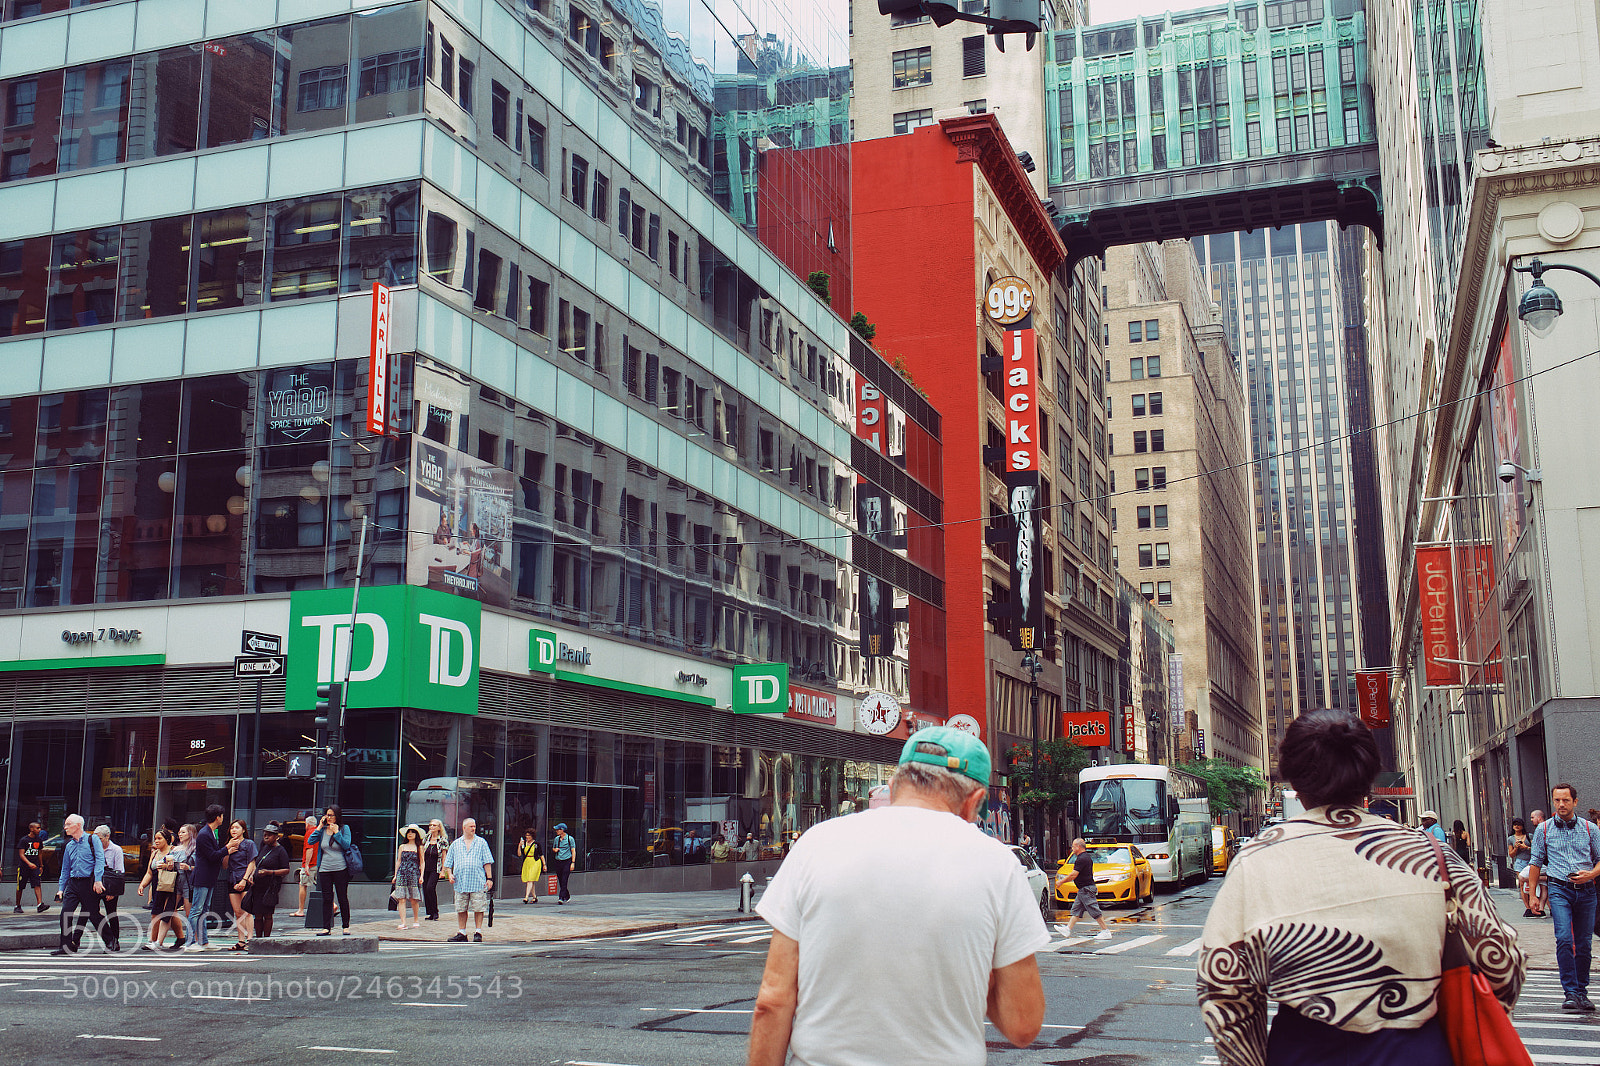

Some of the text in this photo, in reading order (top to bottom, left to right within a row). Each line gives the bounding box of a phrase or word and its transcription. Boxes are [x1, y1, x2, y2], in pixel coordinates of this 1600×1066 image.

[988, 285, 1031, 319] 99¢
[375, 291, 386, 417] BARILLA
[290, 373, 309, 386] THE
[269, 386, 328, 417] YARD
[1008, 330, 1031, 470] jacks
[270, 416, 323, 429] SPACE TO WORK
[420, 460, 443, 481] YARD
[1017, 490, 1029, 570] TWININGS
[1425, 562, 1450, 671] JCPenney
[61, 628, 142, 645] Open 7 Days
[302, 613, 389, 683] TD
[419, 613, 473, 687] TD
[536, 637, 592, 665] TD Bank
[262, 662, 276, 670] WAY
[740, 675, 780, 704] TD
[1366, 675, 1379, 719] JCPenney
[869, 707, 889, 721] PRET
[1069, 720, 1105, 739] jack's
[190, 740, 206, 749] 885
